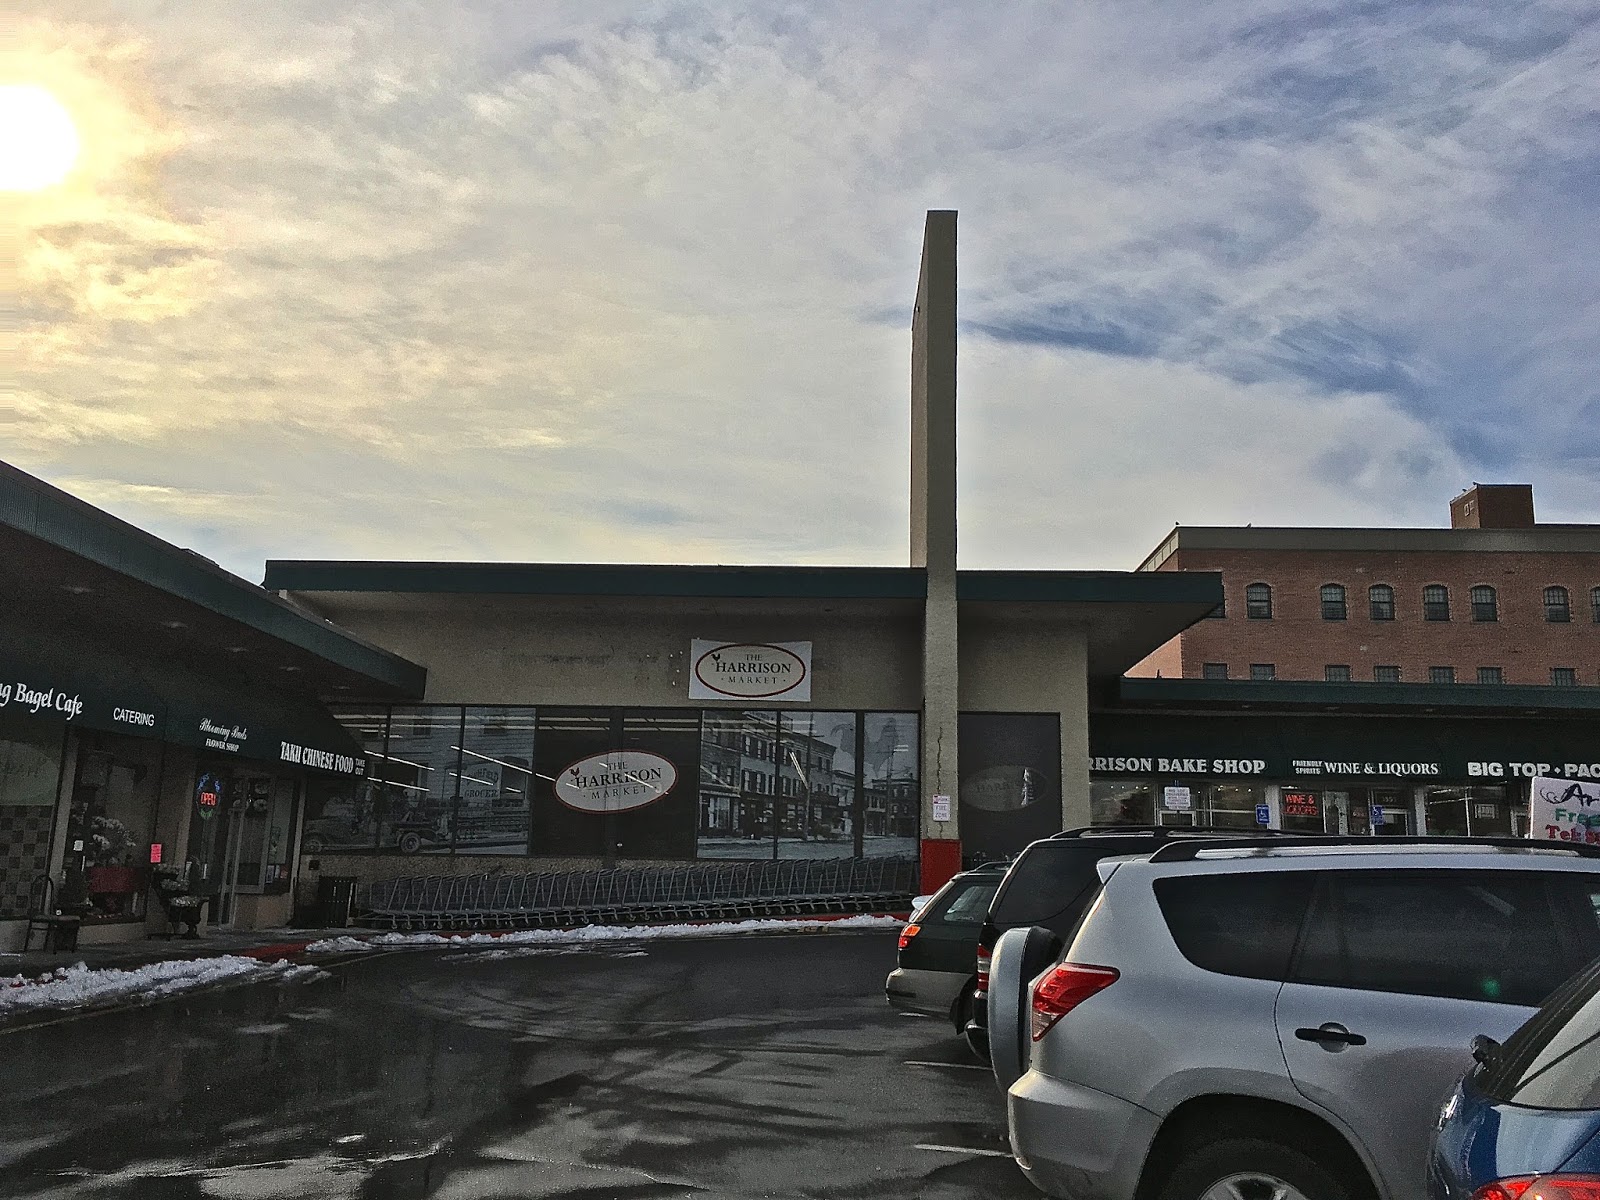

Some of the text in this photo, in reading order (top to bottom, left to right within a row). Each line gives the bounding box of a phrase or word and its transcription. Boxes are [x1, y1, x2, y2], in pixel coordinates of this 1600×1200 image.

[745, 653, 763, 661] THE
[715, 662, 791, 673] HARRISON
[728, 676, 778, 684] MARKET
[13, 682, 54, 714] Bagel
[55, 692, 84, 721] Cafe
[112, 707, 155, 727] CATERING
[205, 738, 240, 753] FLOWER SHOP
[302, 747, 334, 771] CHINESE
[334, 754, 354, 774] FOOD
[355, 757, 366, 768] TAKE
[607, 762, 628, 771] THE
[1157, 758, 1208, 773] BAKE
[1212, 759, 1266, 774] SHOP
[354, 767, 364, 776] OUT
[1295, 767, 1321, 775] SPIRITS
[1324, 762, 1440, 777] WINE & LIQUORS
[1467, 762, 1600, 778] BIG TOP PAC
[575, 768, 662, 788] HARRISON
[199, 791, 217, 807] OPEN
[591, 785, 649, 800] MARKET
[1285, 794, 1315, 805] WINE &
